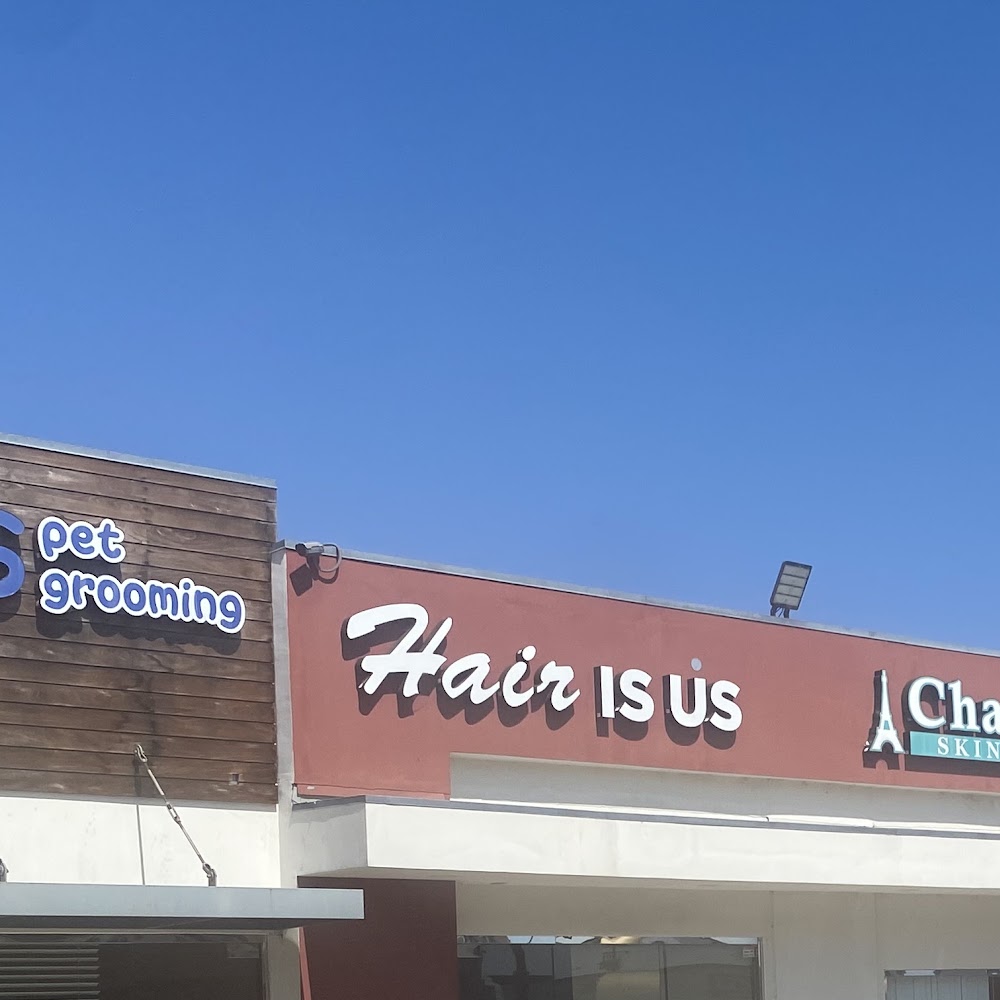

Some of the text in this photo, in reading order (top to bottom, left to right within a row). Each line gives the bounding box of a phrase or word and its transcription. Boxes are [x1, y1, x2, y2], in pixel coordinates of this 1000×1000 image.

[38, 516, 126, 563] pet
[39, 568, 245, 634] grooming
[346, 603, 743, 732] Hair IS US
[937, 737, 1000, 759] SKIN
